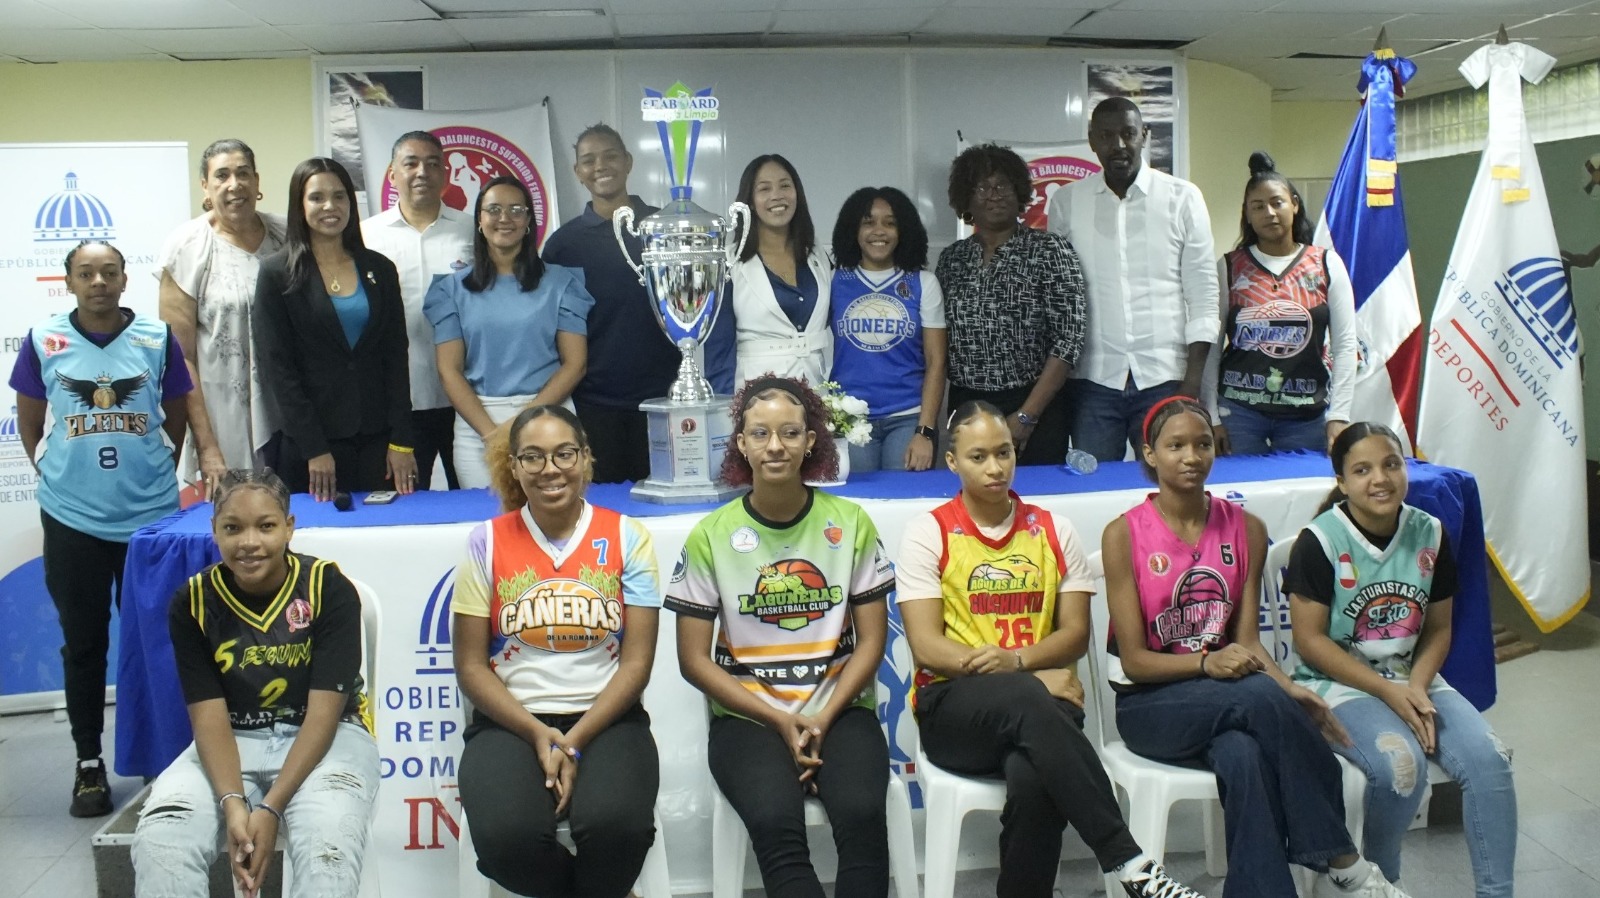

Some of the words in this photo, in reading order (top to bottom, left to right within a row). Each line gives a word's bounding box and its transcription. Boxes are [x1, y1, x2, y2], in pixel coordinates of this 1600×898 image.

[440, 134, 498, 152] BALONCESTO
[498, 146, 534, 183] SUPERIOR
[528, 181, 544, 226] FEMENINO
[837, 318, 916, 338] PIONEERS
[1481, 290, 1524, 347] GOBIERNO
[1523, 347, 1540, 366] DE
[1537, 365, 1552, 383] LA
[1428, 328, 1509, 432] DEPORTES
[1498, 339, 1579, 448] DOMINICANA
[65, 412, 148, 438] ELITES
[98, 446, 119, 470] 8
[1, 491, 12, 502] DE
[593, 538, 608, 565] 7
[1009, 577, 1023, 590] DE
[500, 589, 622, 636] CAÑERAS
[738, 586, 843, 615] LAGUNERAS
[757, 603, 808, 616] BASKETBALL
[809, 601, 829, 611] CLUB
[1344, 595, 1366, 618] LAS
[1361, 581, 1416, 600] TURISTAS
[1368, 601, 1410, 629] Este
[995, 617, 1034, 650] 26
[214, 637, 240, 673] 5
[239, 636, 311, 670] ESQUIN
[259, 677, 288, 708] 2
